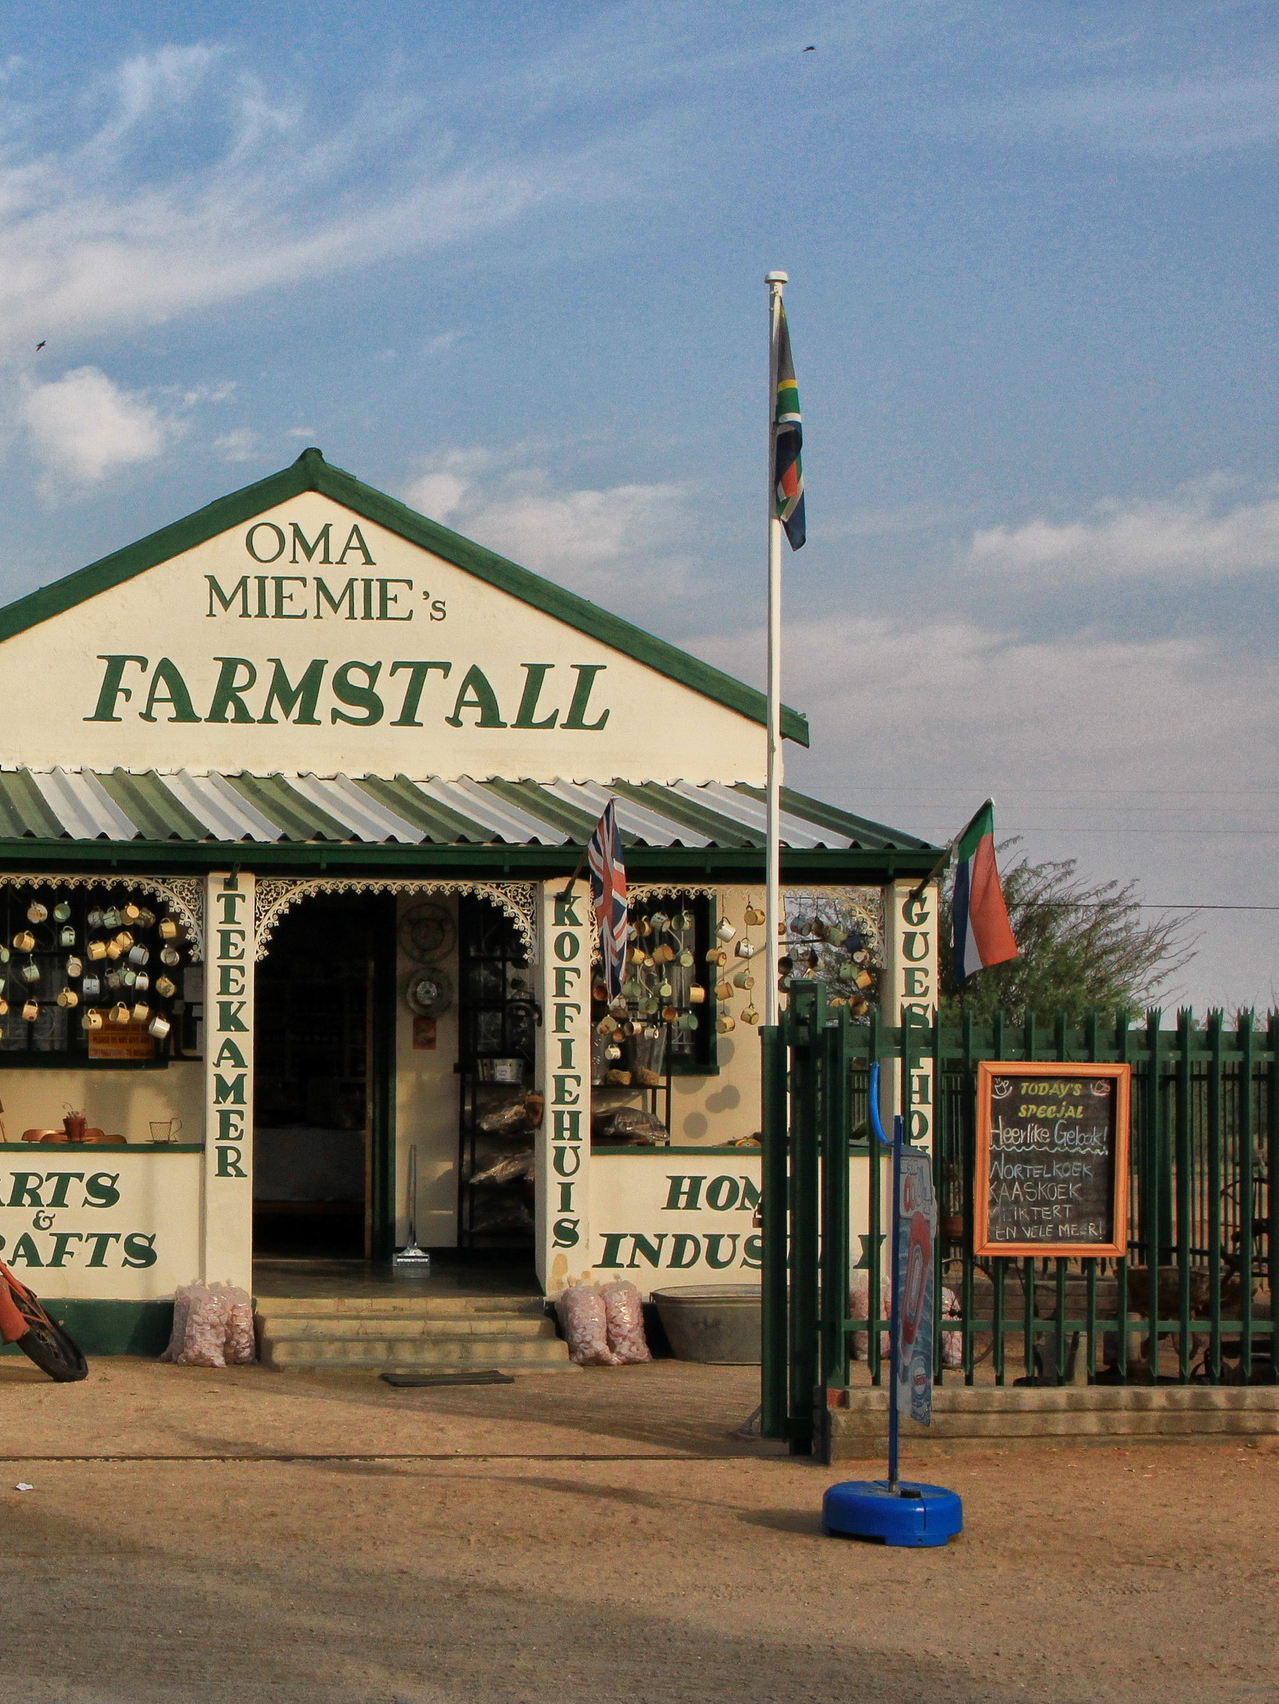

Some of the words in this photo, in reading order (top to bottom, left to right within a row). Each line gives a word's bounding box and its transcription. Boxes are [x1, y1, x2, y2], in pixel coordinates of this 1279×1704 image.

[245, 522, 377, 565] OMA
[204, 575, 447, 621] MIEMIE's
[83, 655, 610, 730] FARMSTALL
[213, 893, 249, 1178] TEEKAMER
[551, 895, 583, 1249] KOFFIEHUIS
[1021, 1082, 1082, 1098] TODAY'S
[989, 1115, 1050, 1145] Heerlike
[661, 1175, 790, 1211] HOM
[32, 1209, 56, 1231] &
